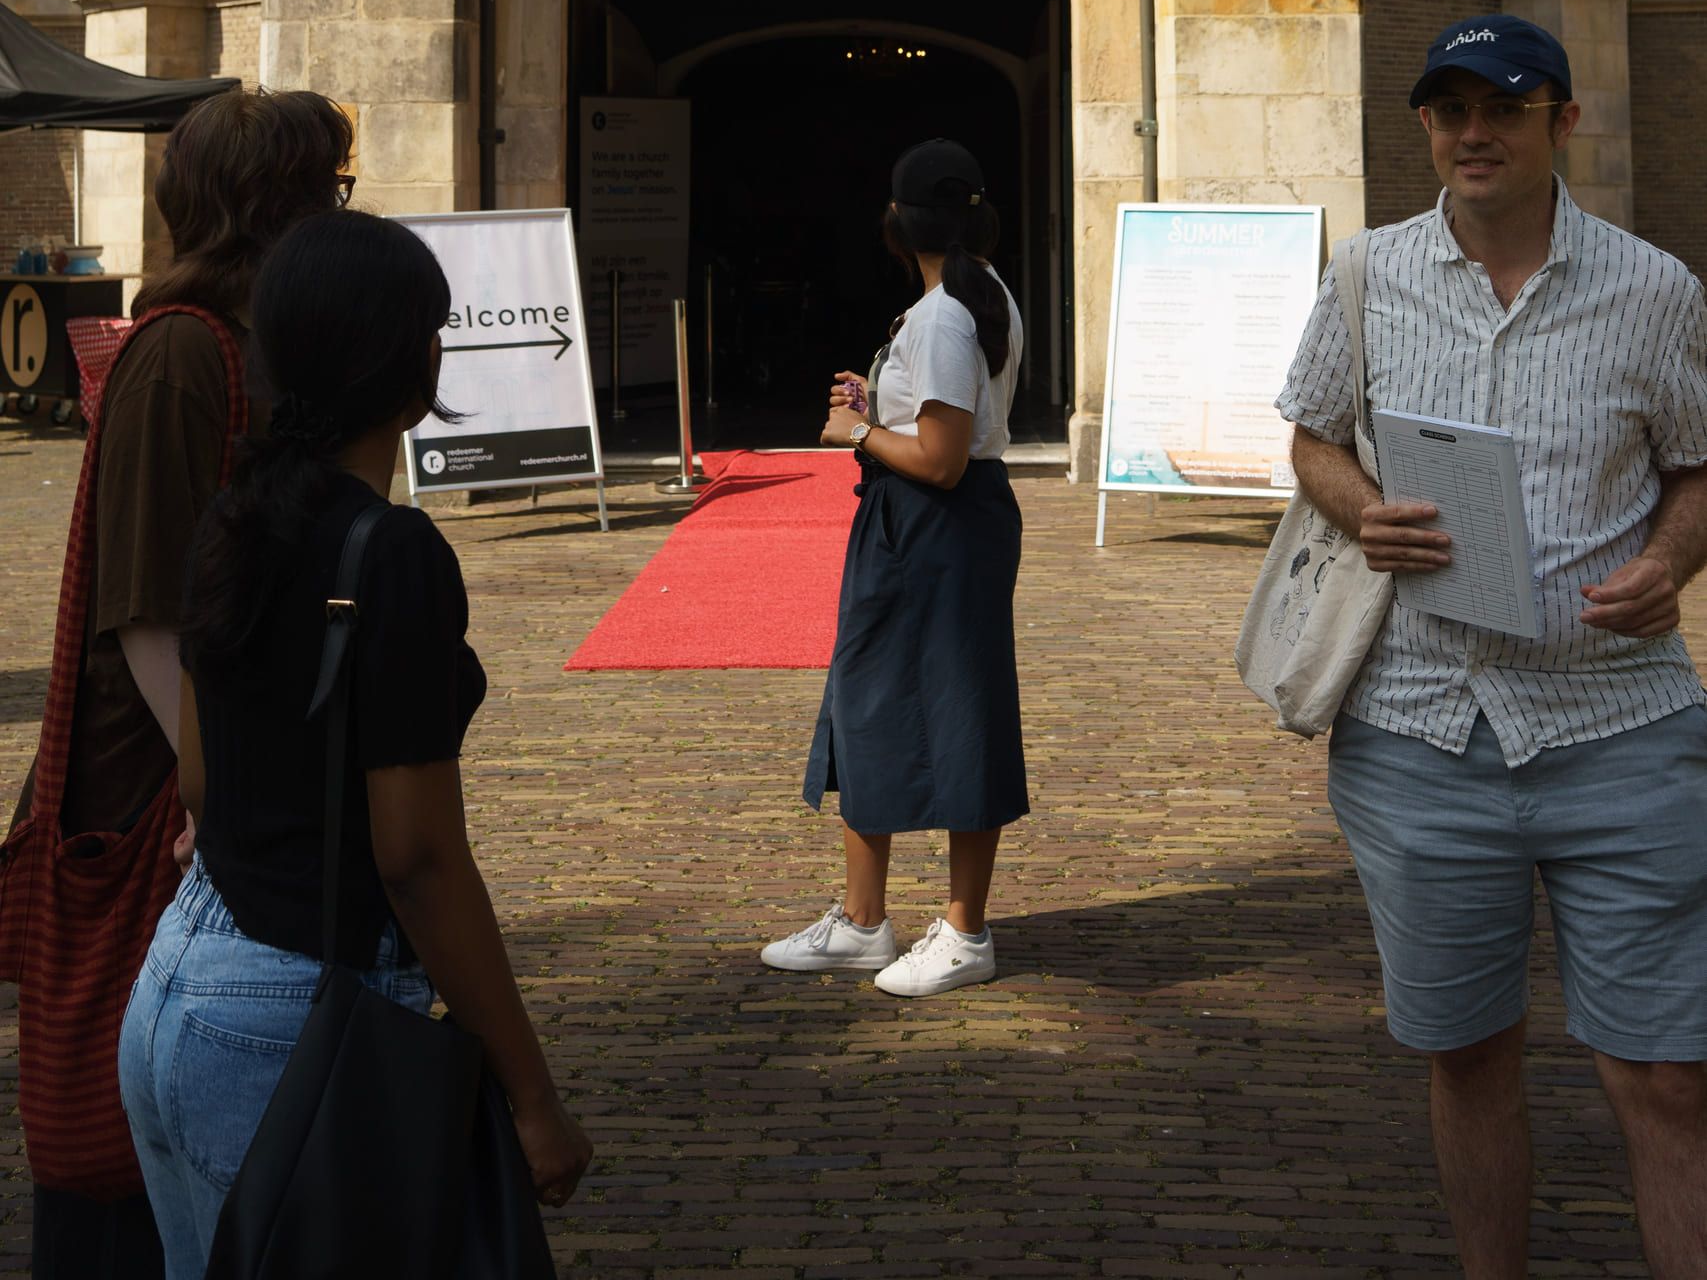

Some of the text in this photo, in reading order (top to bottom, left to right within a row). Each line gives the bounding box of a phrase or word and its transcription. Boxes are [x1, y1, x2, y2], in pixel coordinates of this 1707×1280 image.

[445, 305, 570, 329] elcome
[447, 448, 484, 456] redeemer
[447, 453, 494, 464] international
[520, 453, 588, 466] redeemerchurch.nl
[448, 463, 475, 472] church
